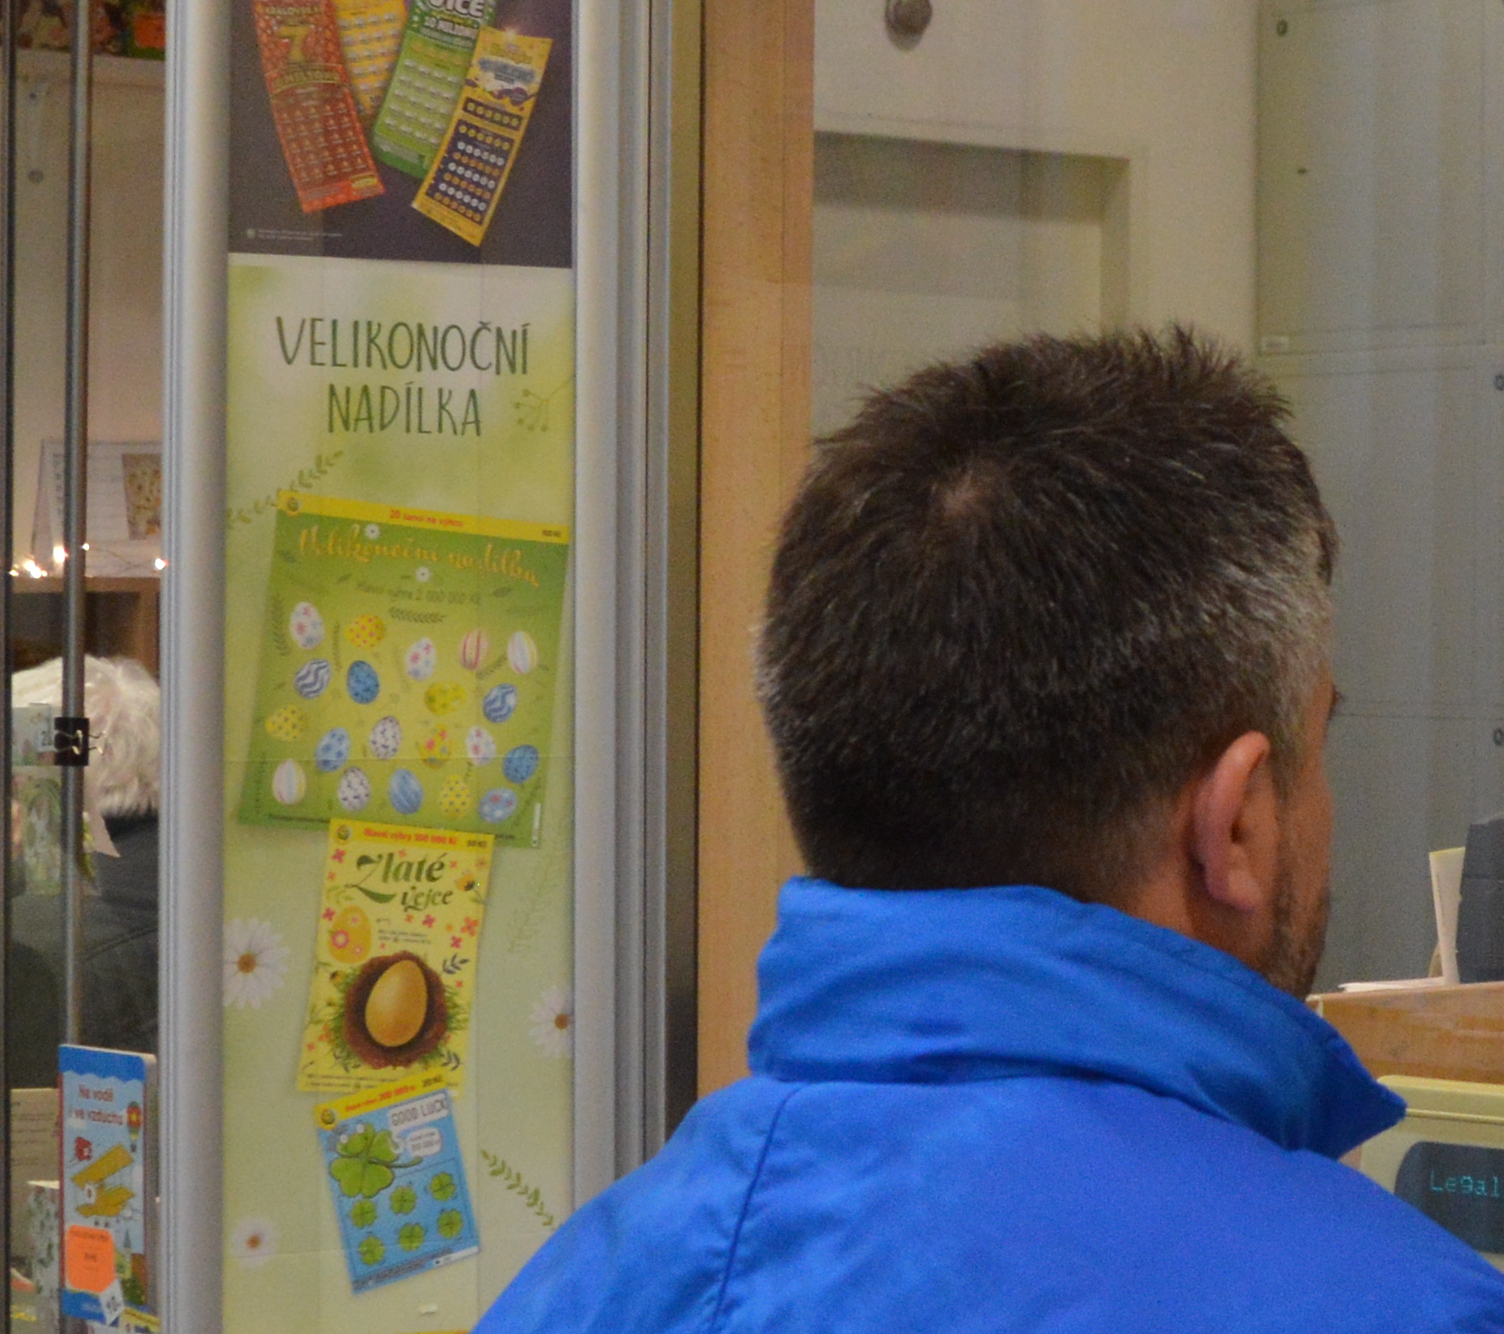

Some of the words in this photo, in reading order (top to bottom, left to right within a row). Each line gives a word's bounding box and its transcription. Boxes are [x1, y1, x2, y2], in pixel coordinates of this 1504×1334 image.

[276, 316, 531, 375] VELIKONOČNÍ
[328, 381, 482, 436] NADÍLKA
[344, 852, 448, 904] Zlaté
